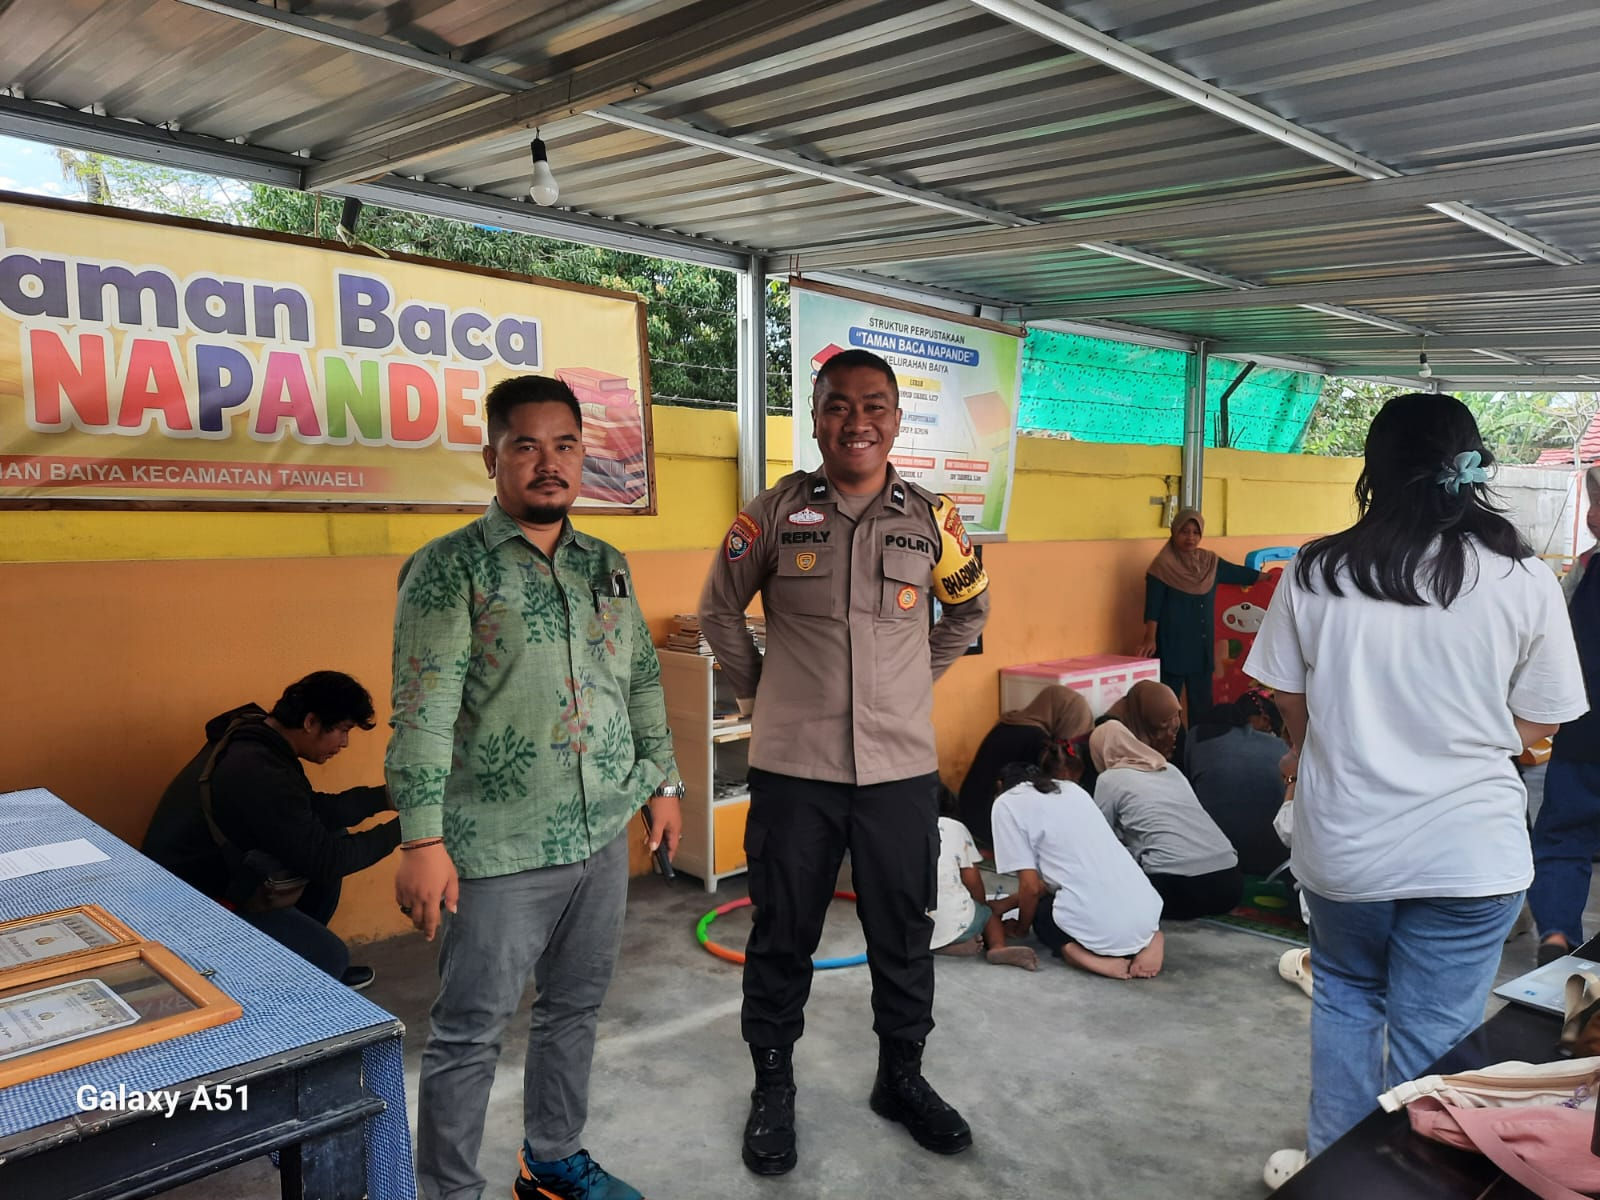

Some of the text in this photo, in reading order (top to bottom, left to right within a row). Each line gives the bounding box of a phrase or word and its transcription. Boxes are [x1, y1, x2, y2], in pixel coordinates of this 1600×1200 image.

[0, 254, 539, 366] aman Baca
[868, 317, 965, 344] STRUKTUR PERPUSTAKAAN
[898, 338, 925, 353] BACA
[883, 355, 949, 374] KELURAHAN BAIYA
[29, 329, 483, 446] NAPANDE
[50, 463, 126, 481] BAIYA
[132, 465, 272, 485] KECAMATAN
[278, 469, 364, 487] TAWAELI
[782, 530, 831, 544] REPLY
[885, 534, 930, 554] POLRI
